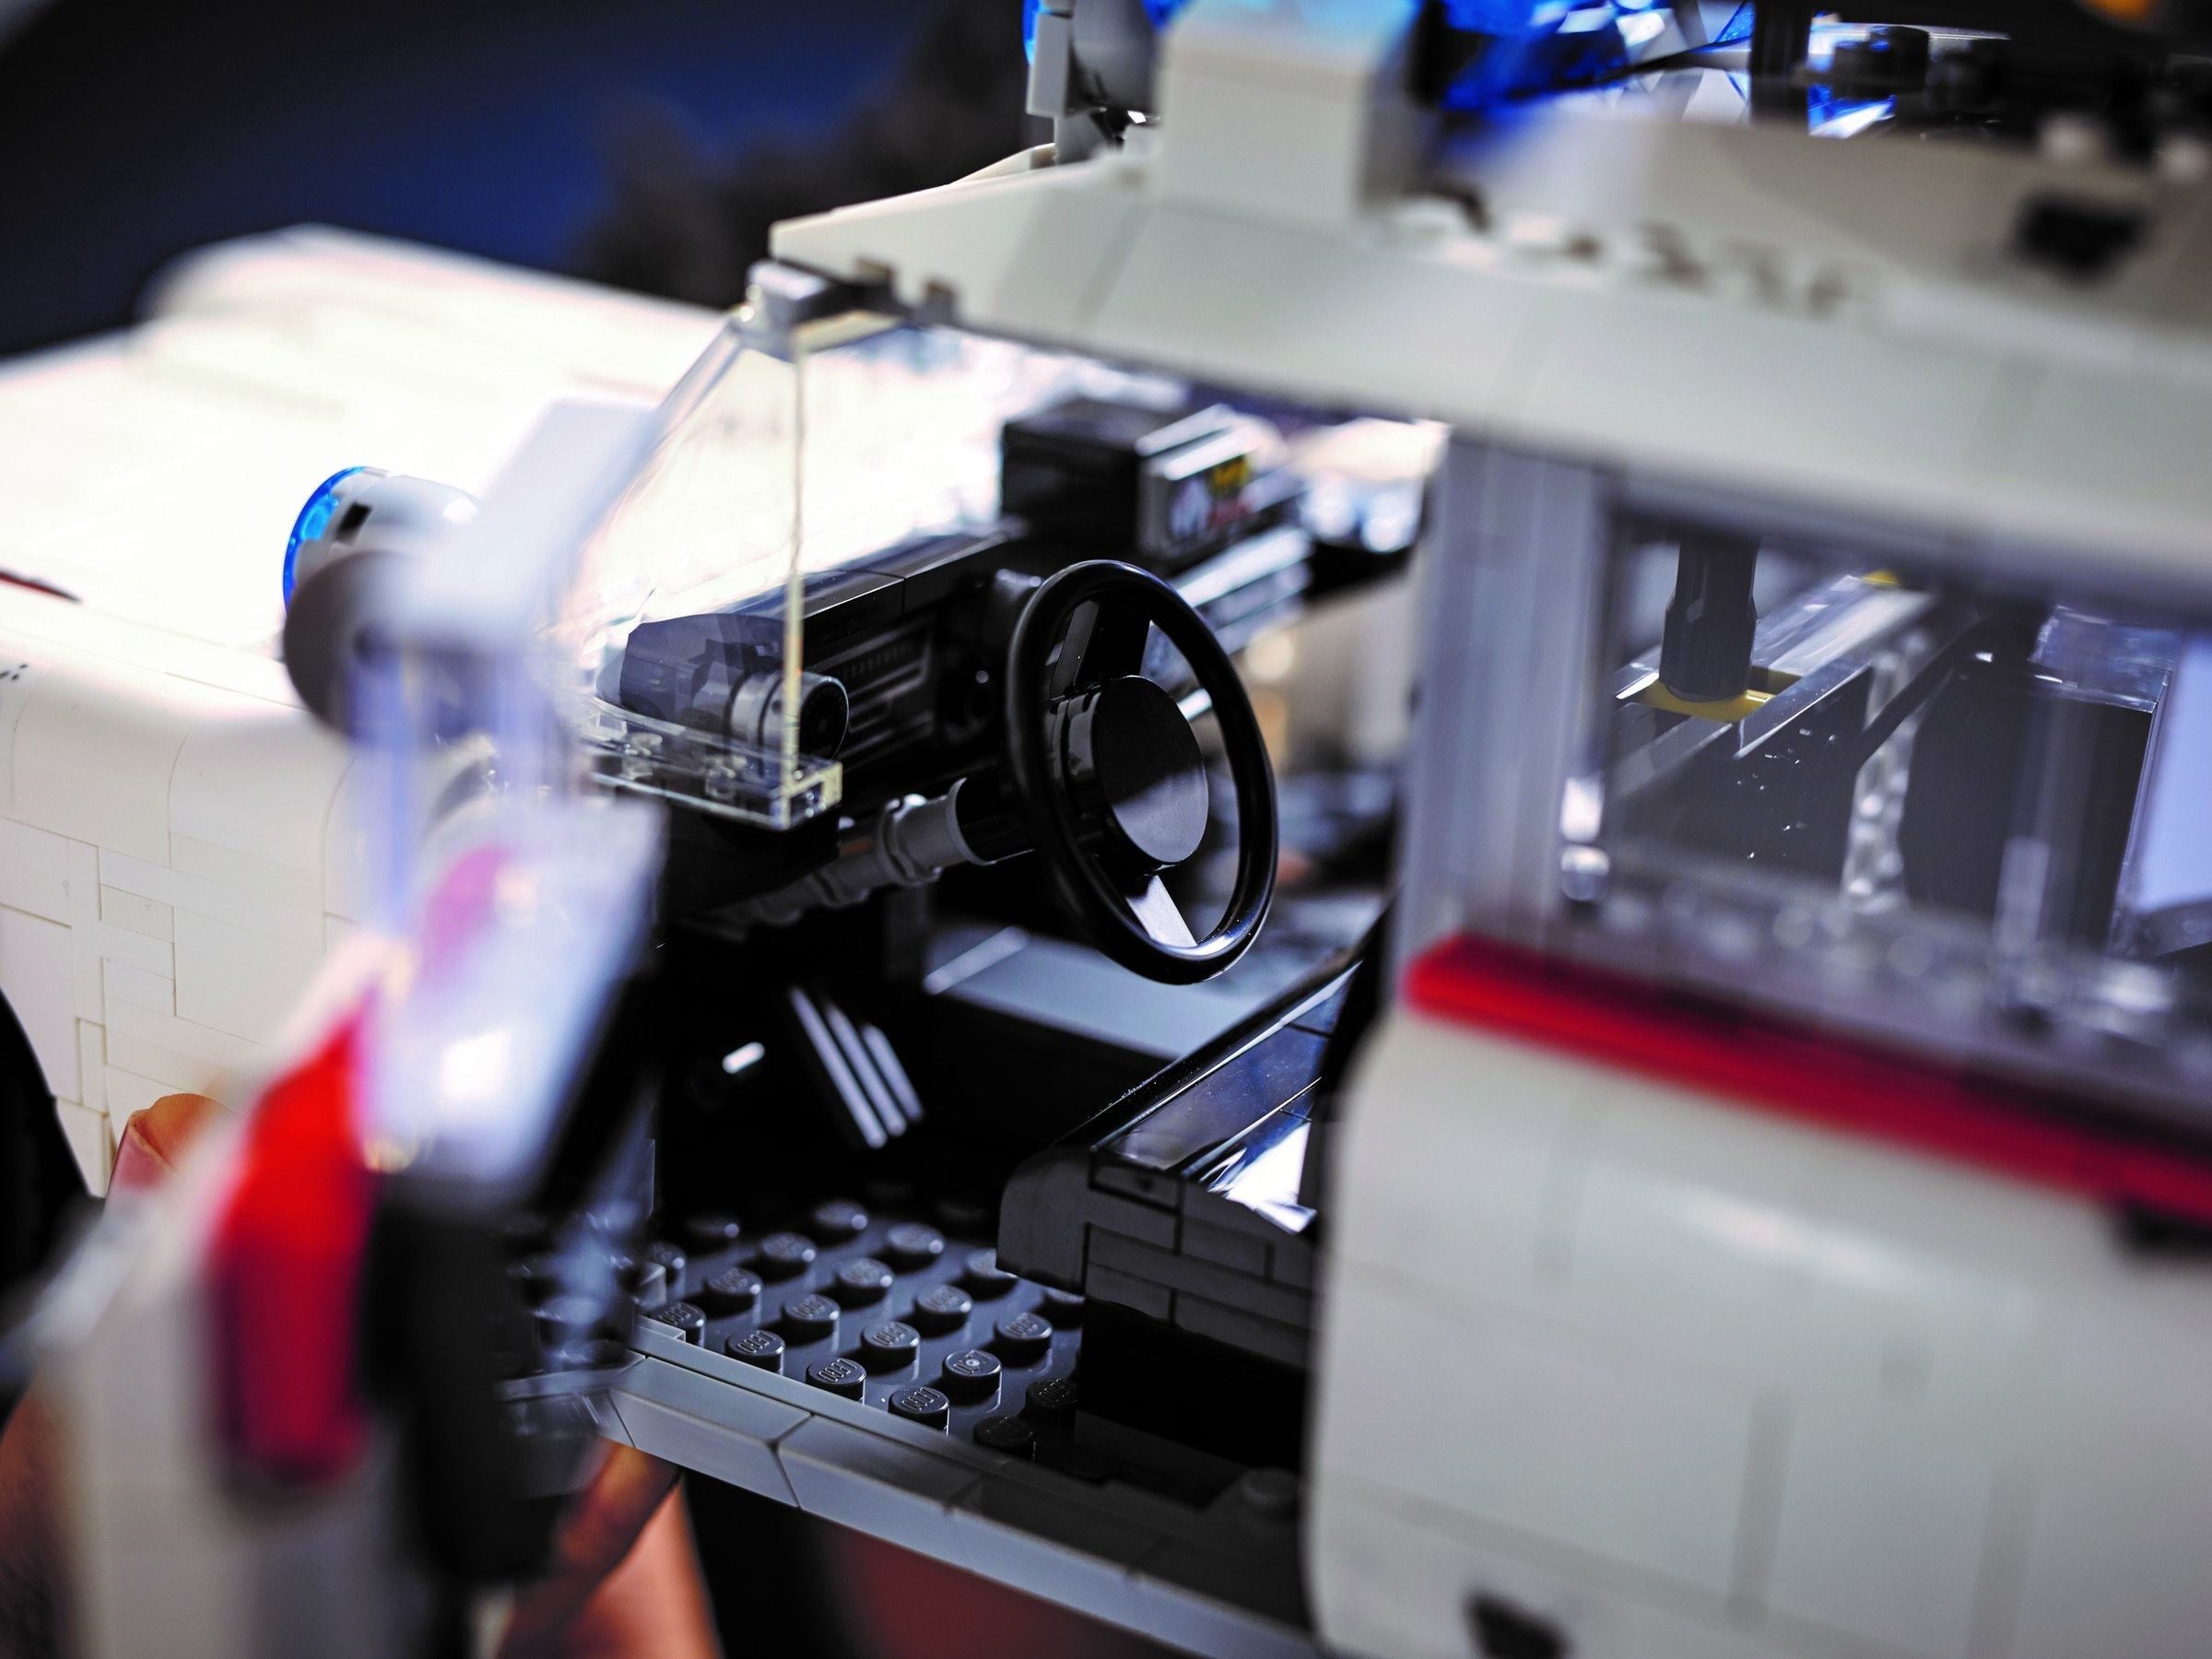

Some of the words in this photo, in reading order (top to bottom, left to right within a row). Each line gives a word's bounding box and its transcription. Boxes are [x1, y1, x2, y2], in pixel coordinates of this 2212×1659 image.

[736, 1329, 777, 1354] LEGO
[818, 1357, 858, 1382] LEGO
[901, 1386, 941, 1412] LEGO
